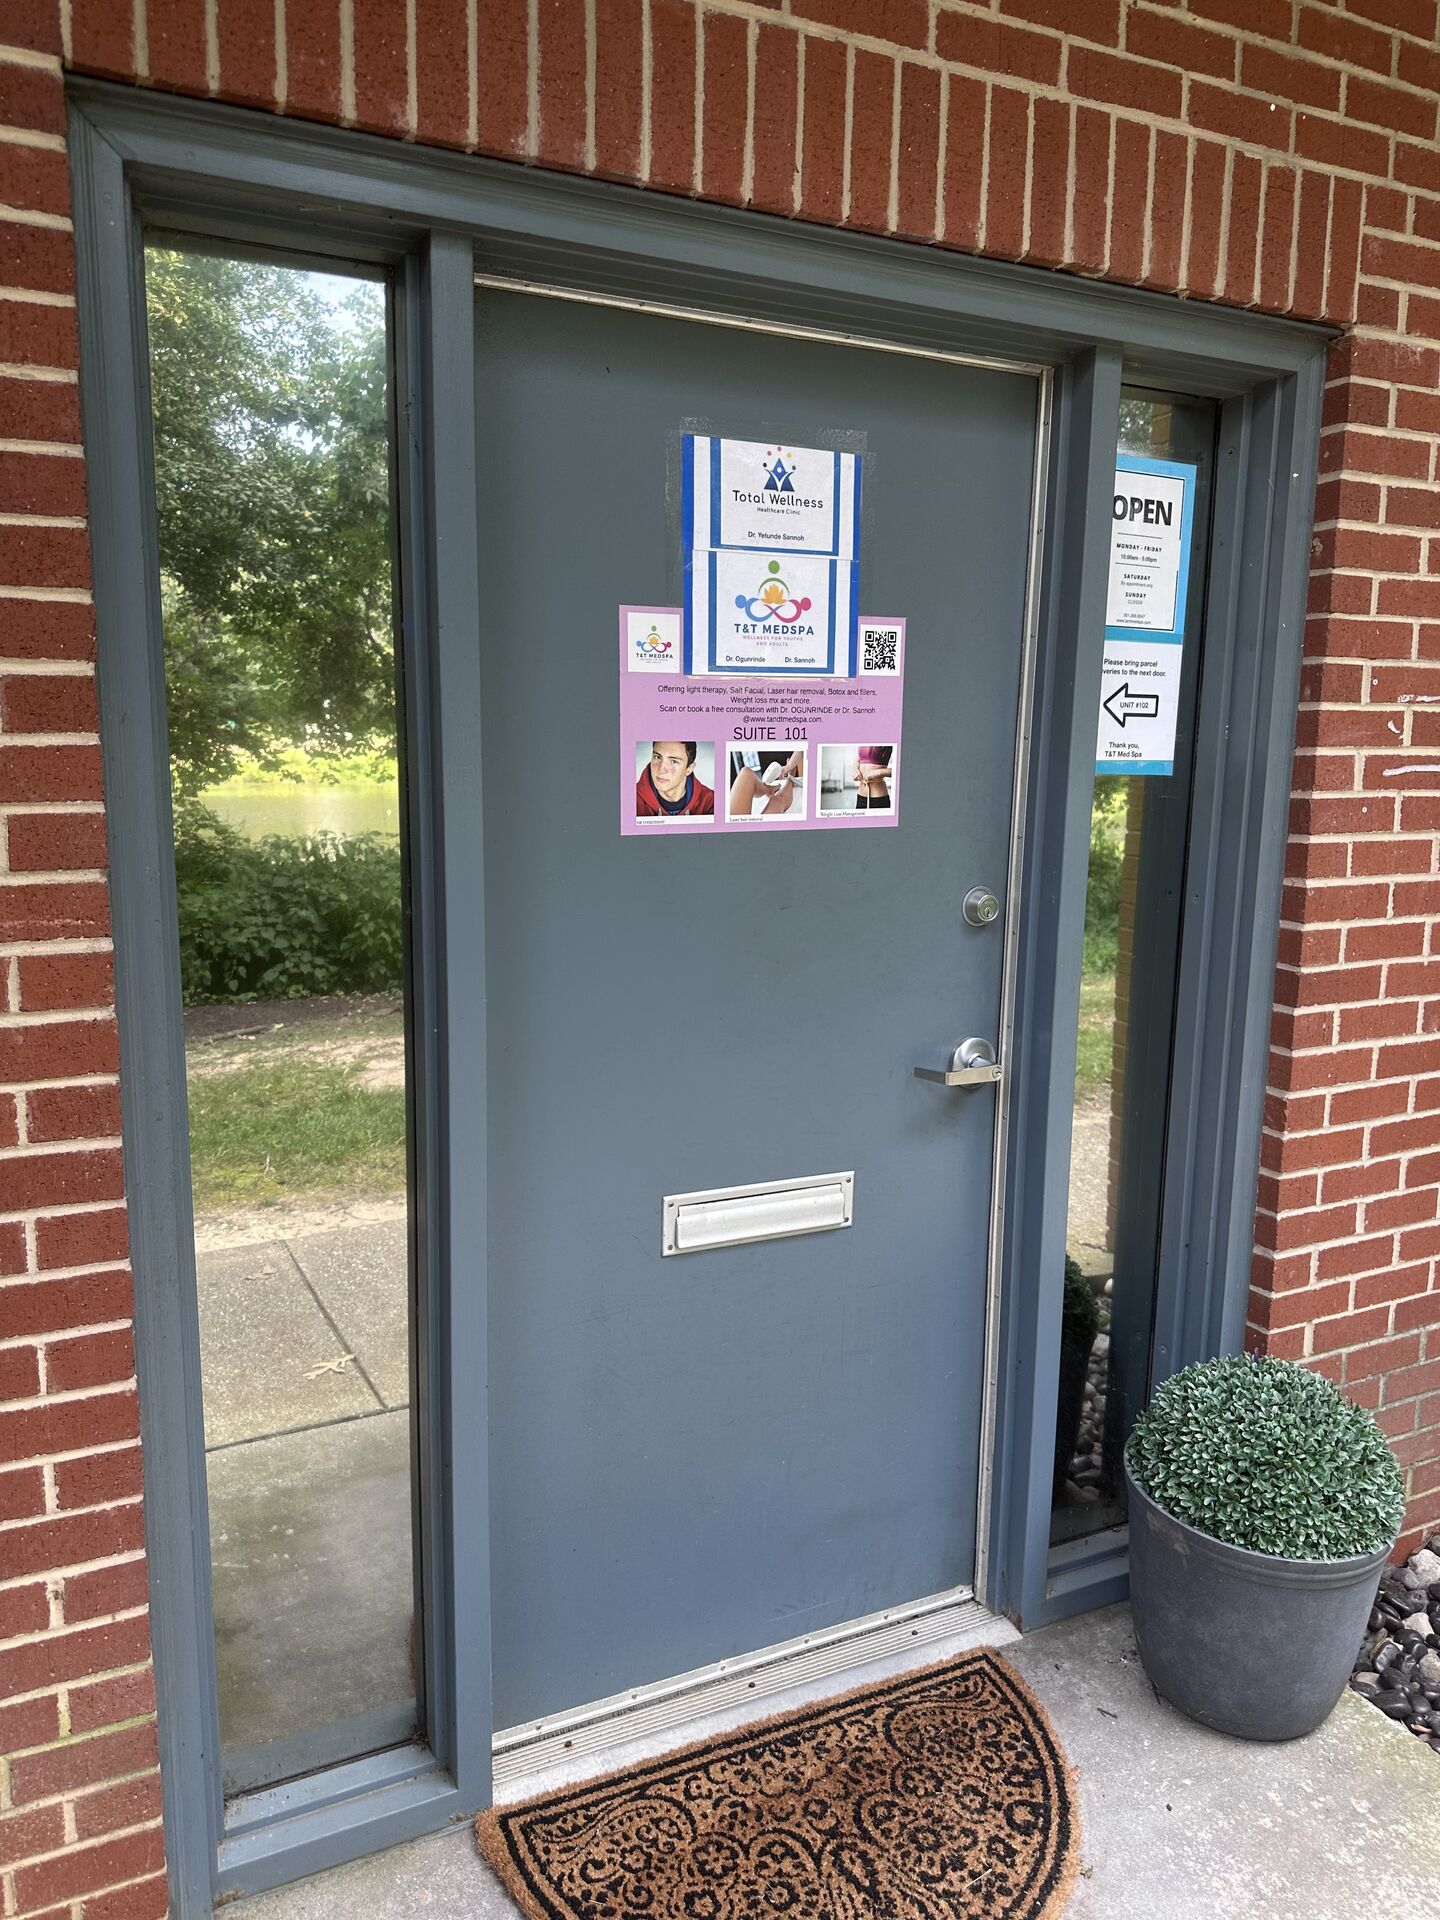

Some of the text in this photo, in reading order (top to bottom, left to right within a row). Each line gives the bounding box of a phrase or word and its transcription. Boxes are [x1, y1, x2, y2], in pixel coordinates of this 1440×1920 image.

[732, 490, 824, 508] Total Wellness
[1113, 495, 1173, 526] OPEN
[758, 532, 781, 540] Yetunde
[734, 624, 814, 635] T&T MEDSPA
[1104, 658, 1158, 668] Please bring parcel
[658, 685, 685, 694] Offering
[687, 685, 700, 694] light
[744, 687, 765, 695] Facial,
[828, 688, 845, 696] Botox
[731, 697, 753, 705] Weight
[711, 705, 724, 713] free
[726, 705, 764, 713] consultation
[791, 706, 833, 714] OGUNRINDE
[733, 727, 807, 740] SUITE 101
[1131, 750, 1142, 759] Spa
